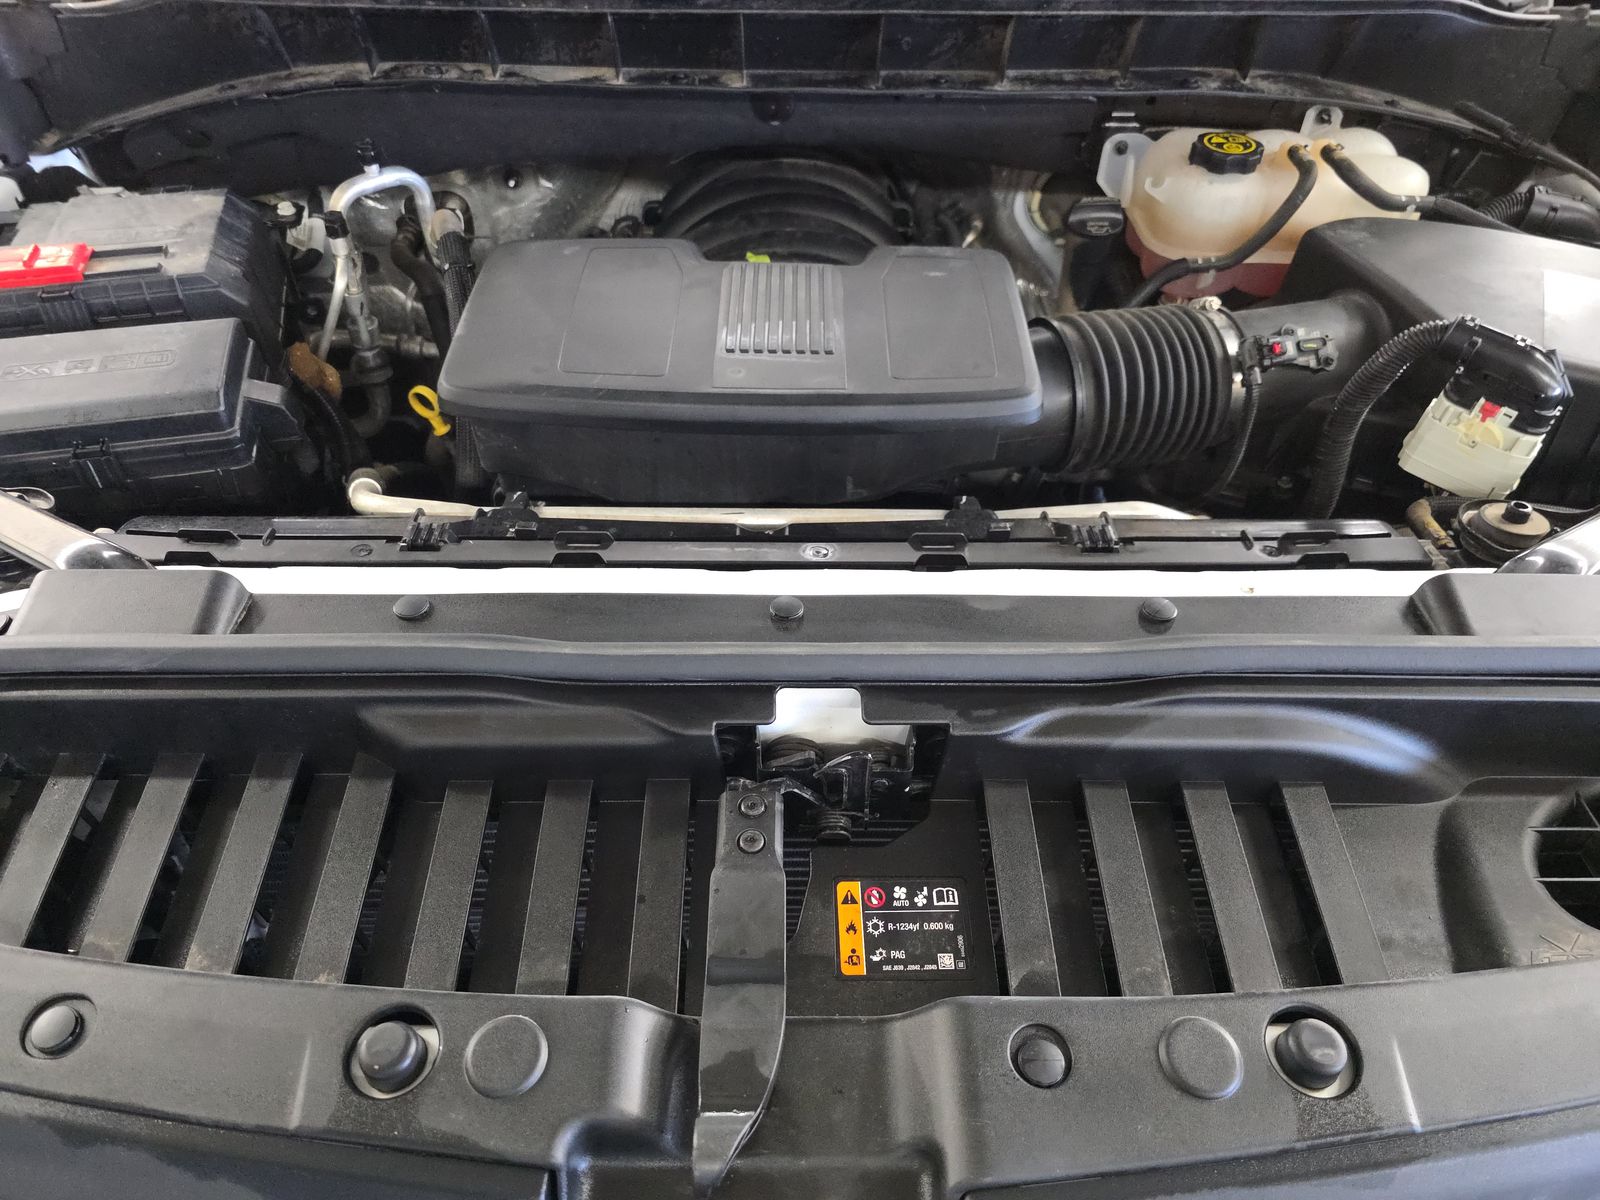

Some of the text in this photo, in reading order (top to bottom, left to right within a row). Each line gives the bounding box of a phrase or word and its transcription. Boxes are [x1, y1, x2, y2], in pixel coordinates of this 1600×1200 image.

[892, 899, 910, 907] AUTO
[887, 922, 954, 932] R-1234yf 0.600 kg
[890, 950, 906, 960] PAG
